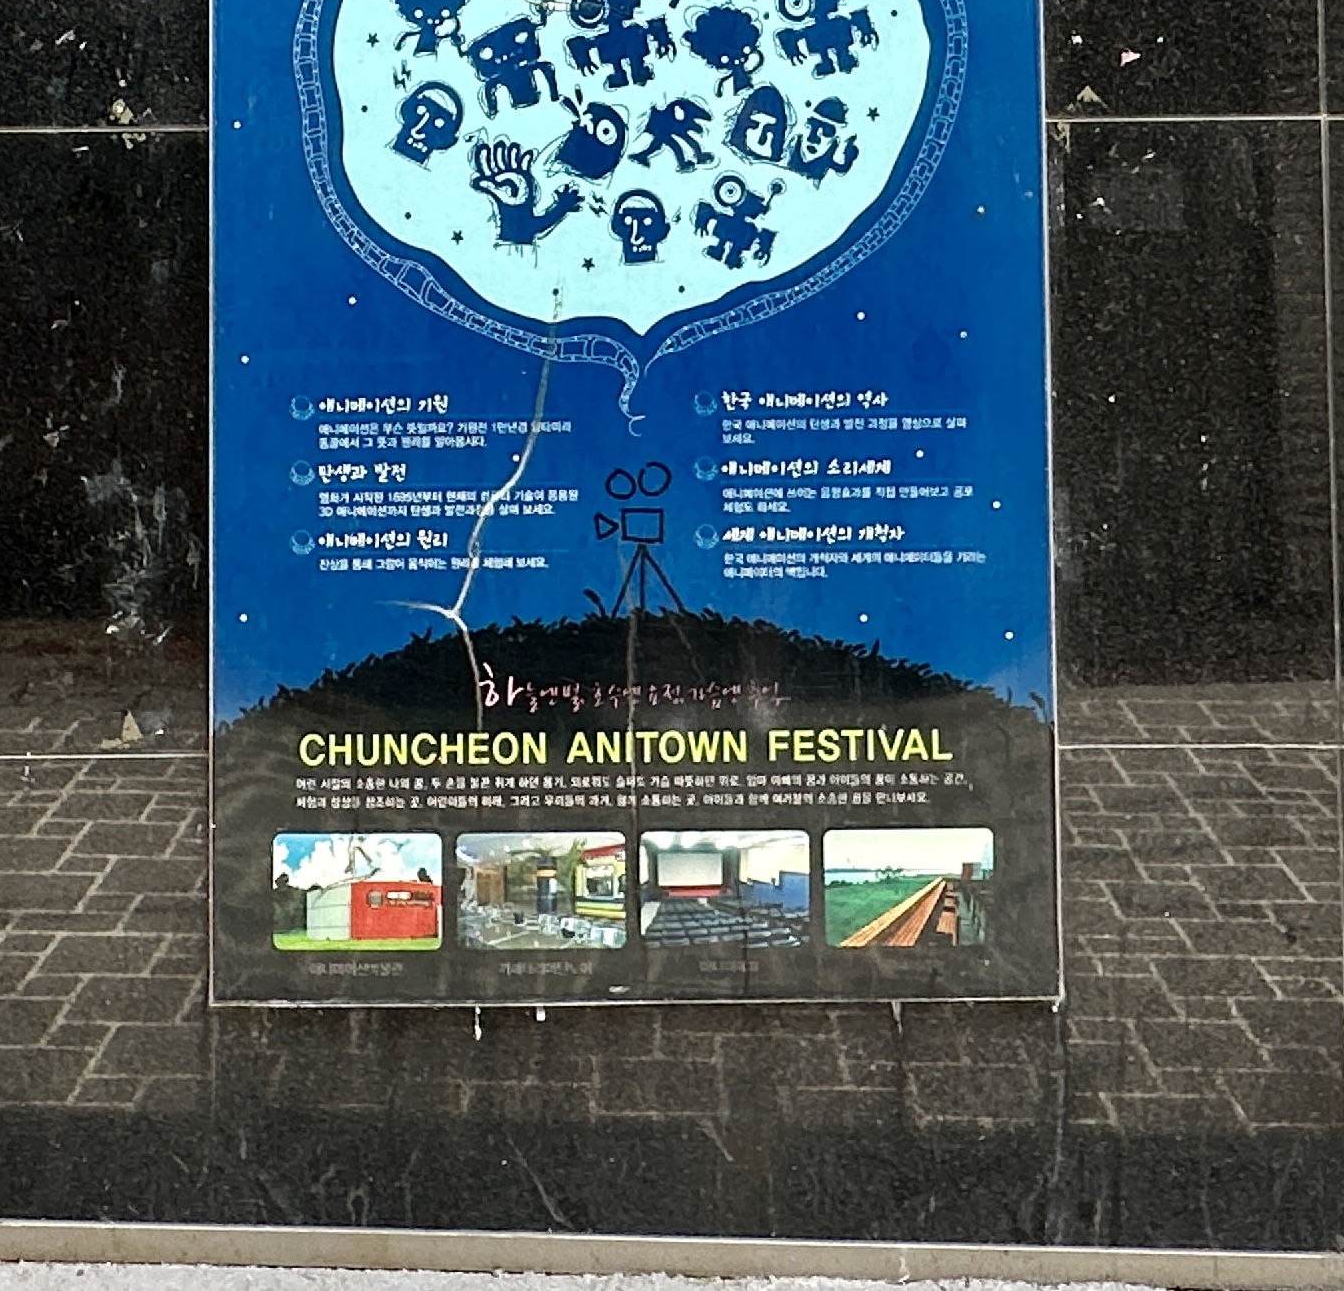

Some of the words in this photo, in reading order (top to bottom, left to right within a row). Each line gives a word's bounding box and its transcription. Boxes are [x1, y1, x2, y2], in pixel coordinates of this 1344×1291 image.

[318, 396, 412, 415] 애니메이션의
[417, 394, 449, 415] 기원
[721, 391, 753, 411] 한국
[758, 391, 851, 410] 애니메이션의
[857, 390, 889, 409] 역사
[374, 462, 407, 483] 발전
[721, 458, 819, 478] 애니메이션의
[318, 532, 411, 550] 애니메이션의
[416, 529, 448, 550] 원리
[759, 524, 852, 544] 애니메이션의
[298, 731, 548, 767] CHUNCHEON
[565, 729, 748, 765] ANITOWN
[768, 727, 954, 763] FESTIVAL
